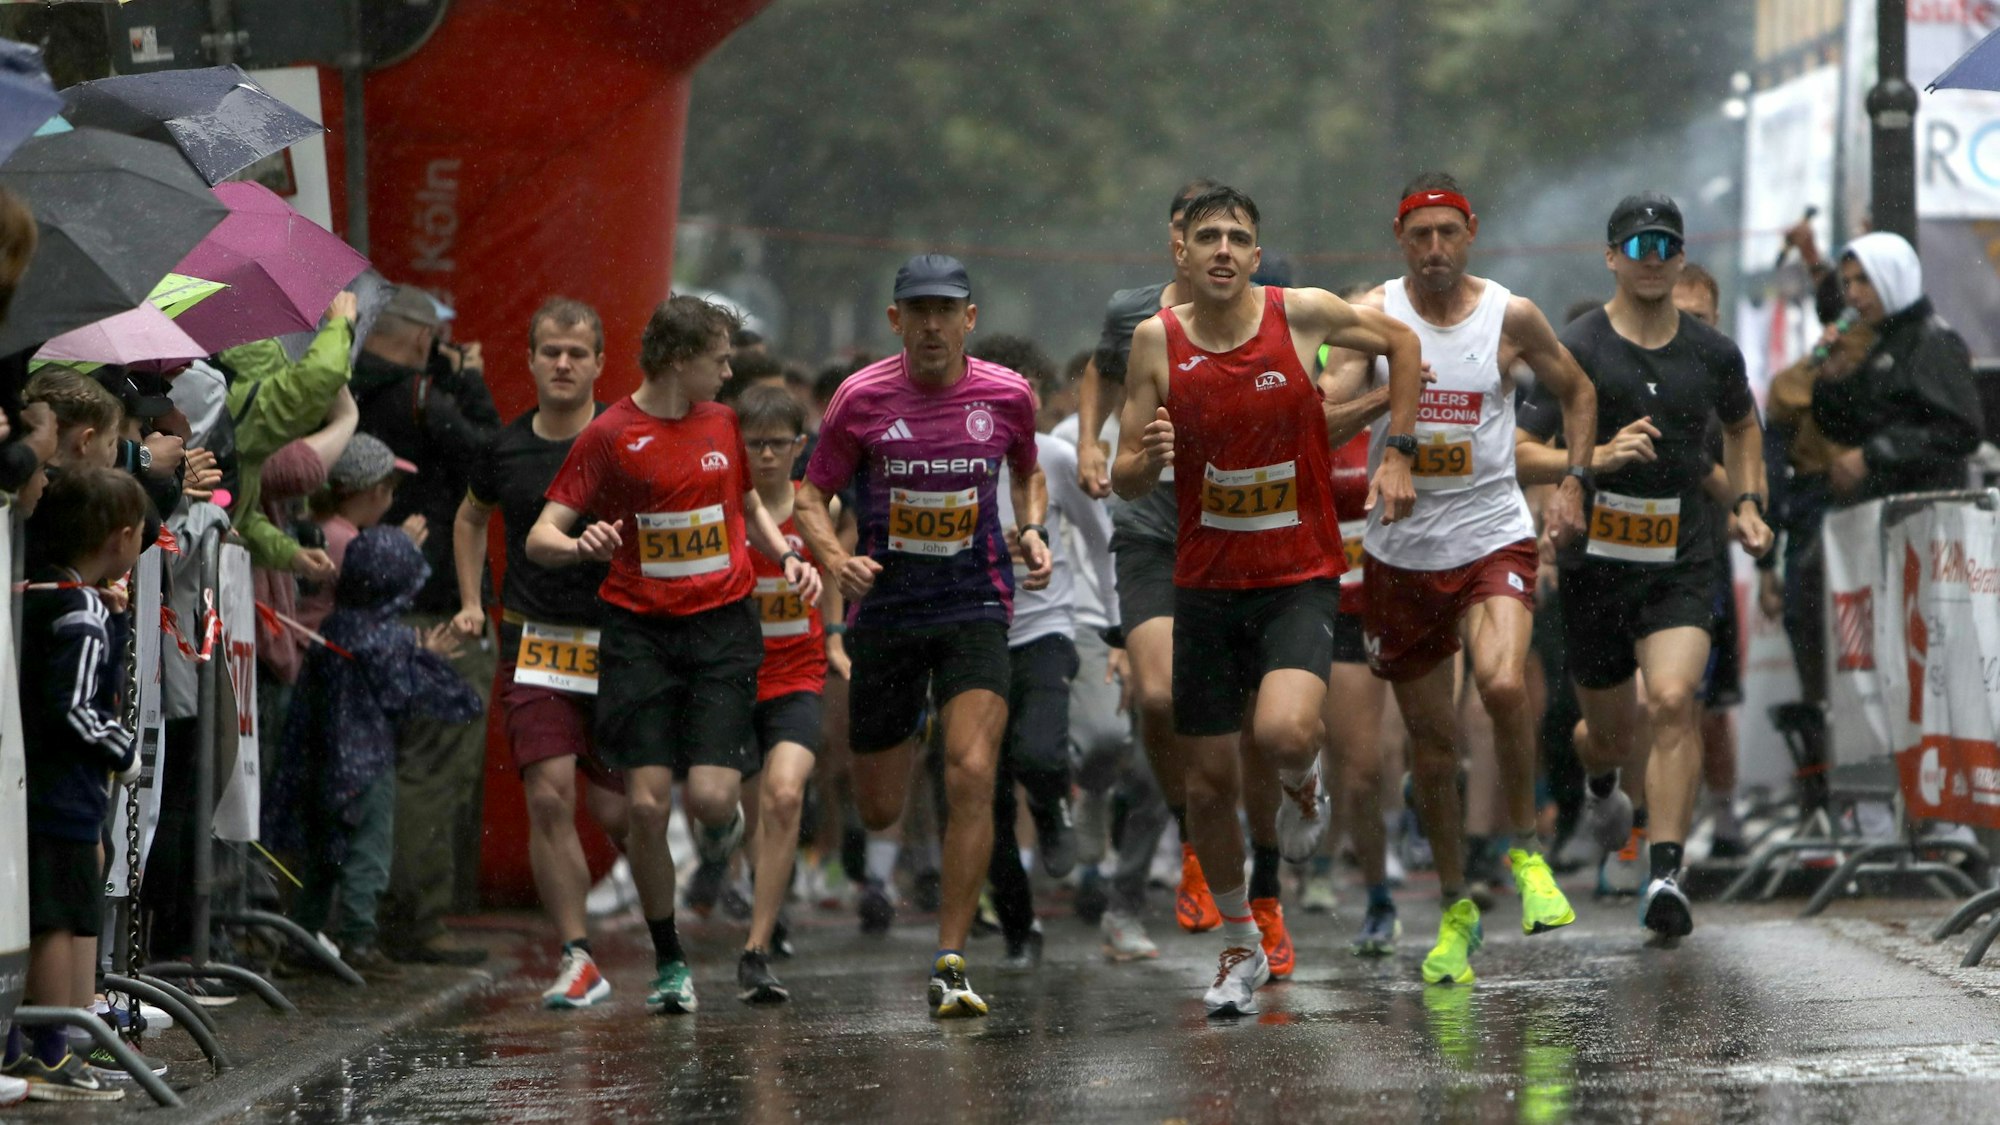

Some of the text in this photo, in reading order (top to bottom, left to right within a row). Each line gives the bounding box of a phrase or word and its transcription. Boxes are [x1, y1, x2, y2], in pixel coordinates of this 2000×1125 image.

[410, 158, 463, 271] Köln
[1255, 376, 1276, 388] LAZ
[1410, 446, 1466, 473] 159
[1207, 482, 1289, 514] 5217
[896, 508, 973, 538] 5054
[1597, 512, 1673, 544] 5130
[646, 525, 723, 558] 5144
[921, 543, 949, 554] John
[754, 592, 804, 620] 143
[524, 641, 600, 674] 5113
